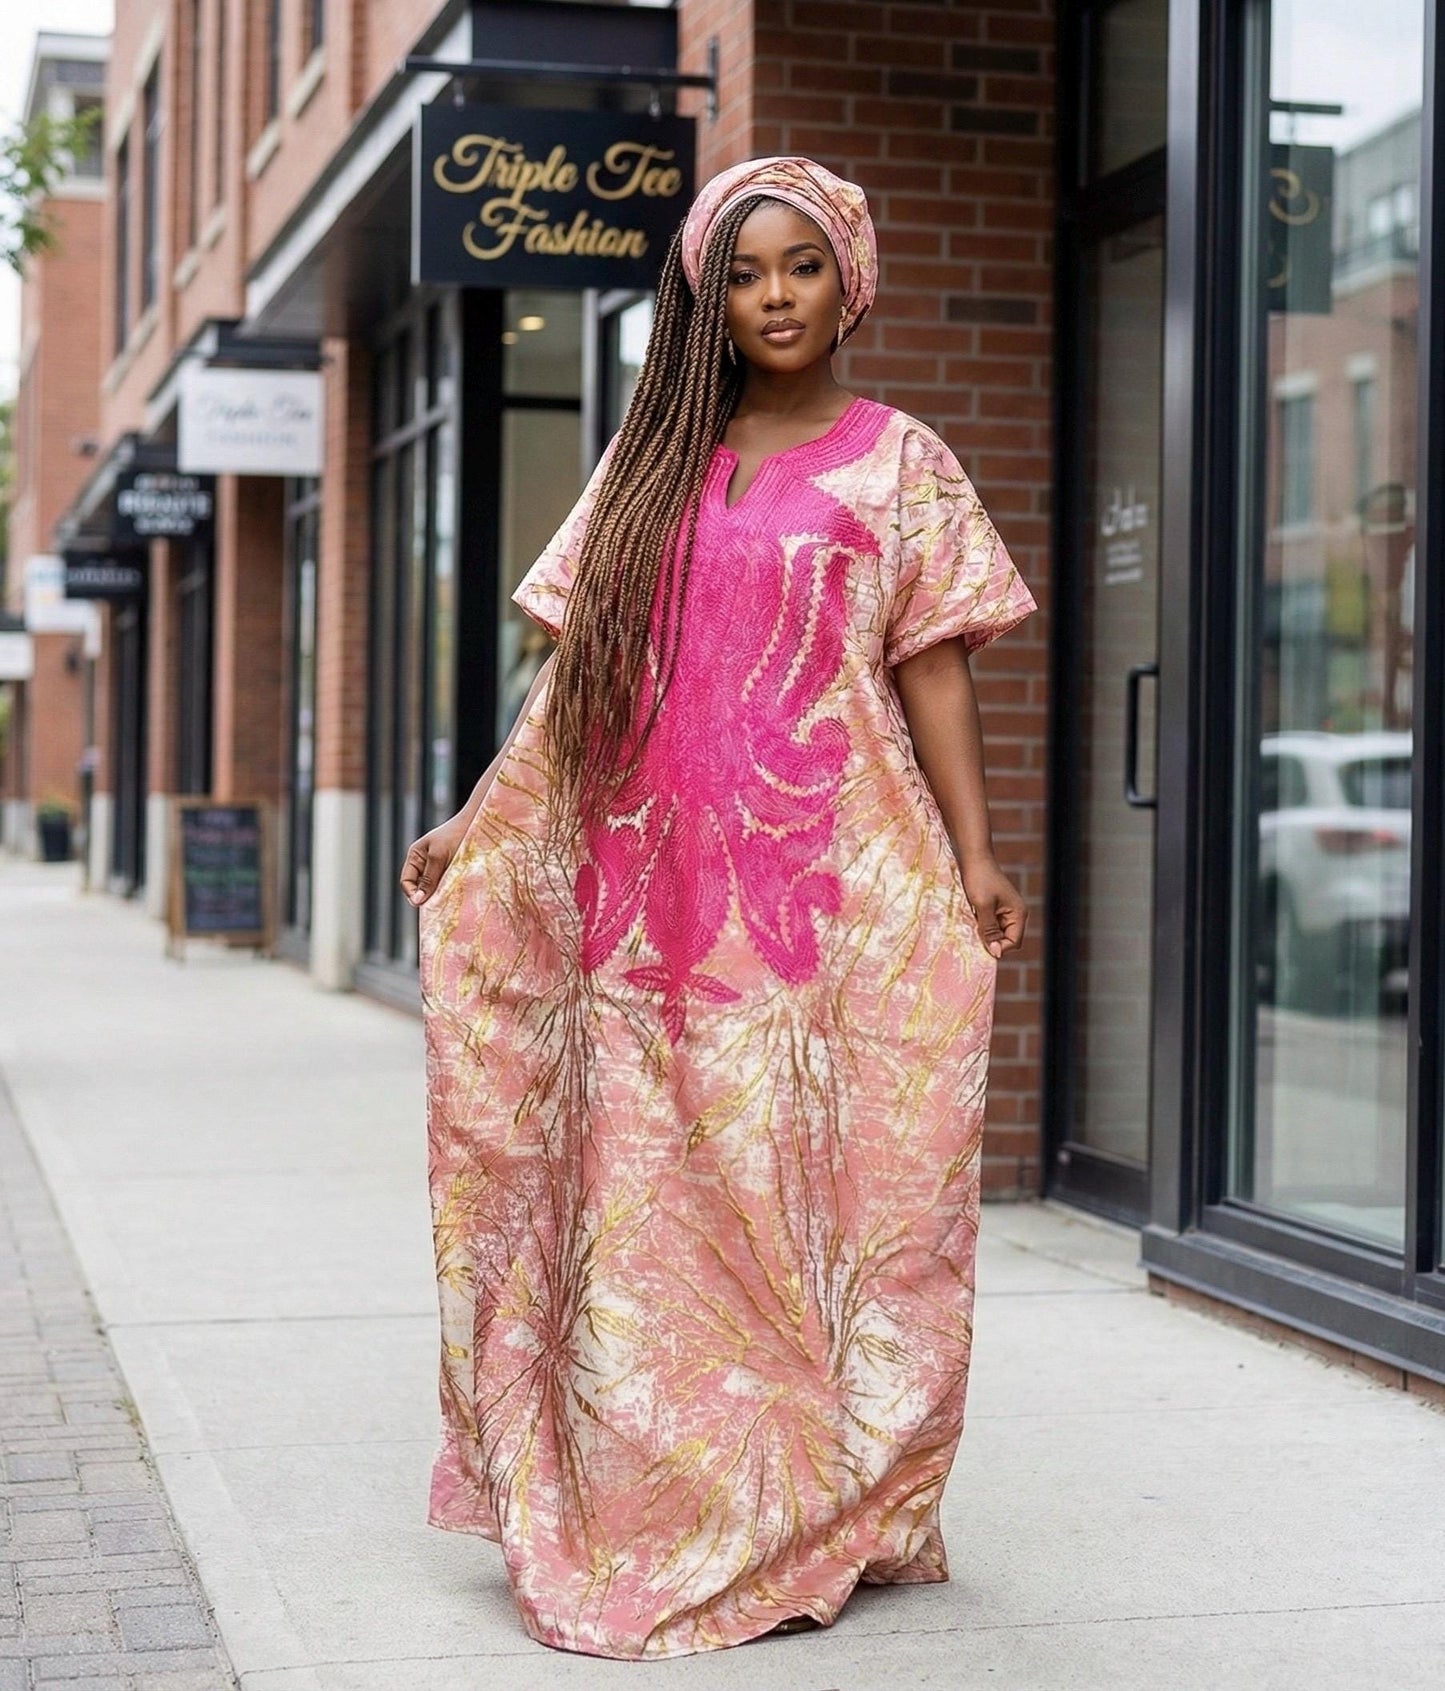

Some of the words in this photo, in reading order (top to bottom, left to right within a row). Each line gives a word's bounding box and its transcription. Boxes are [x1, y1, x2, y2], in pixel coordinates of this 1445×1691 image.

[433, 133, 579, 201] Triple
[586, 141, 682, 200] Tee
[462, 197, 649, 260] Fashion
